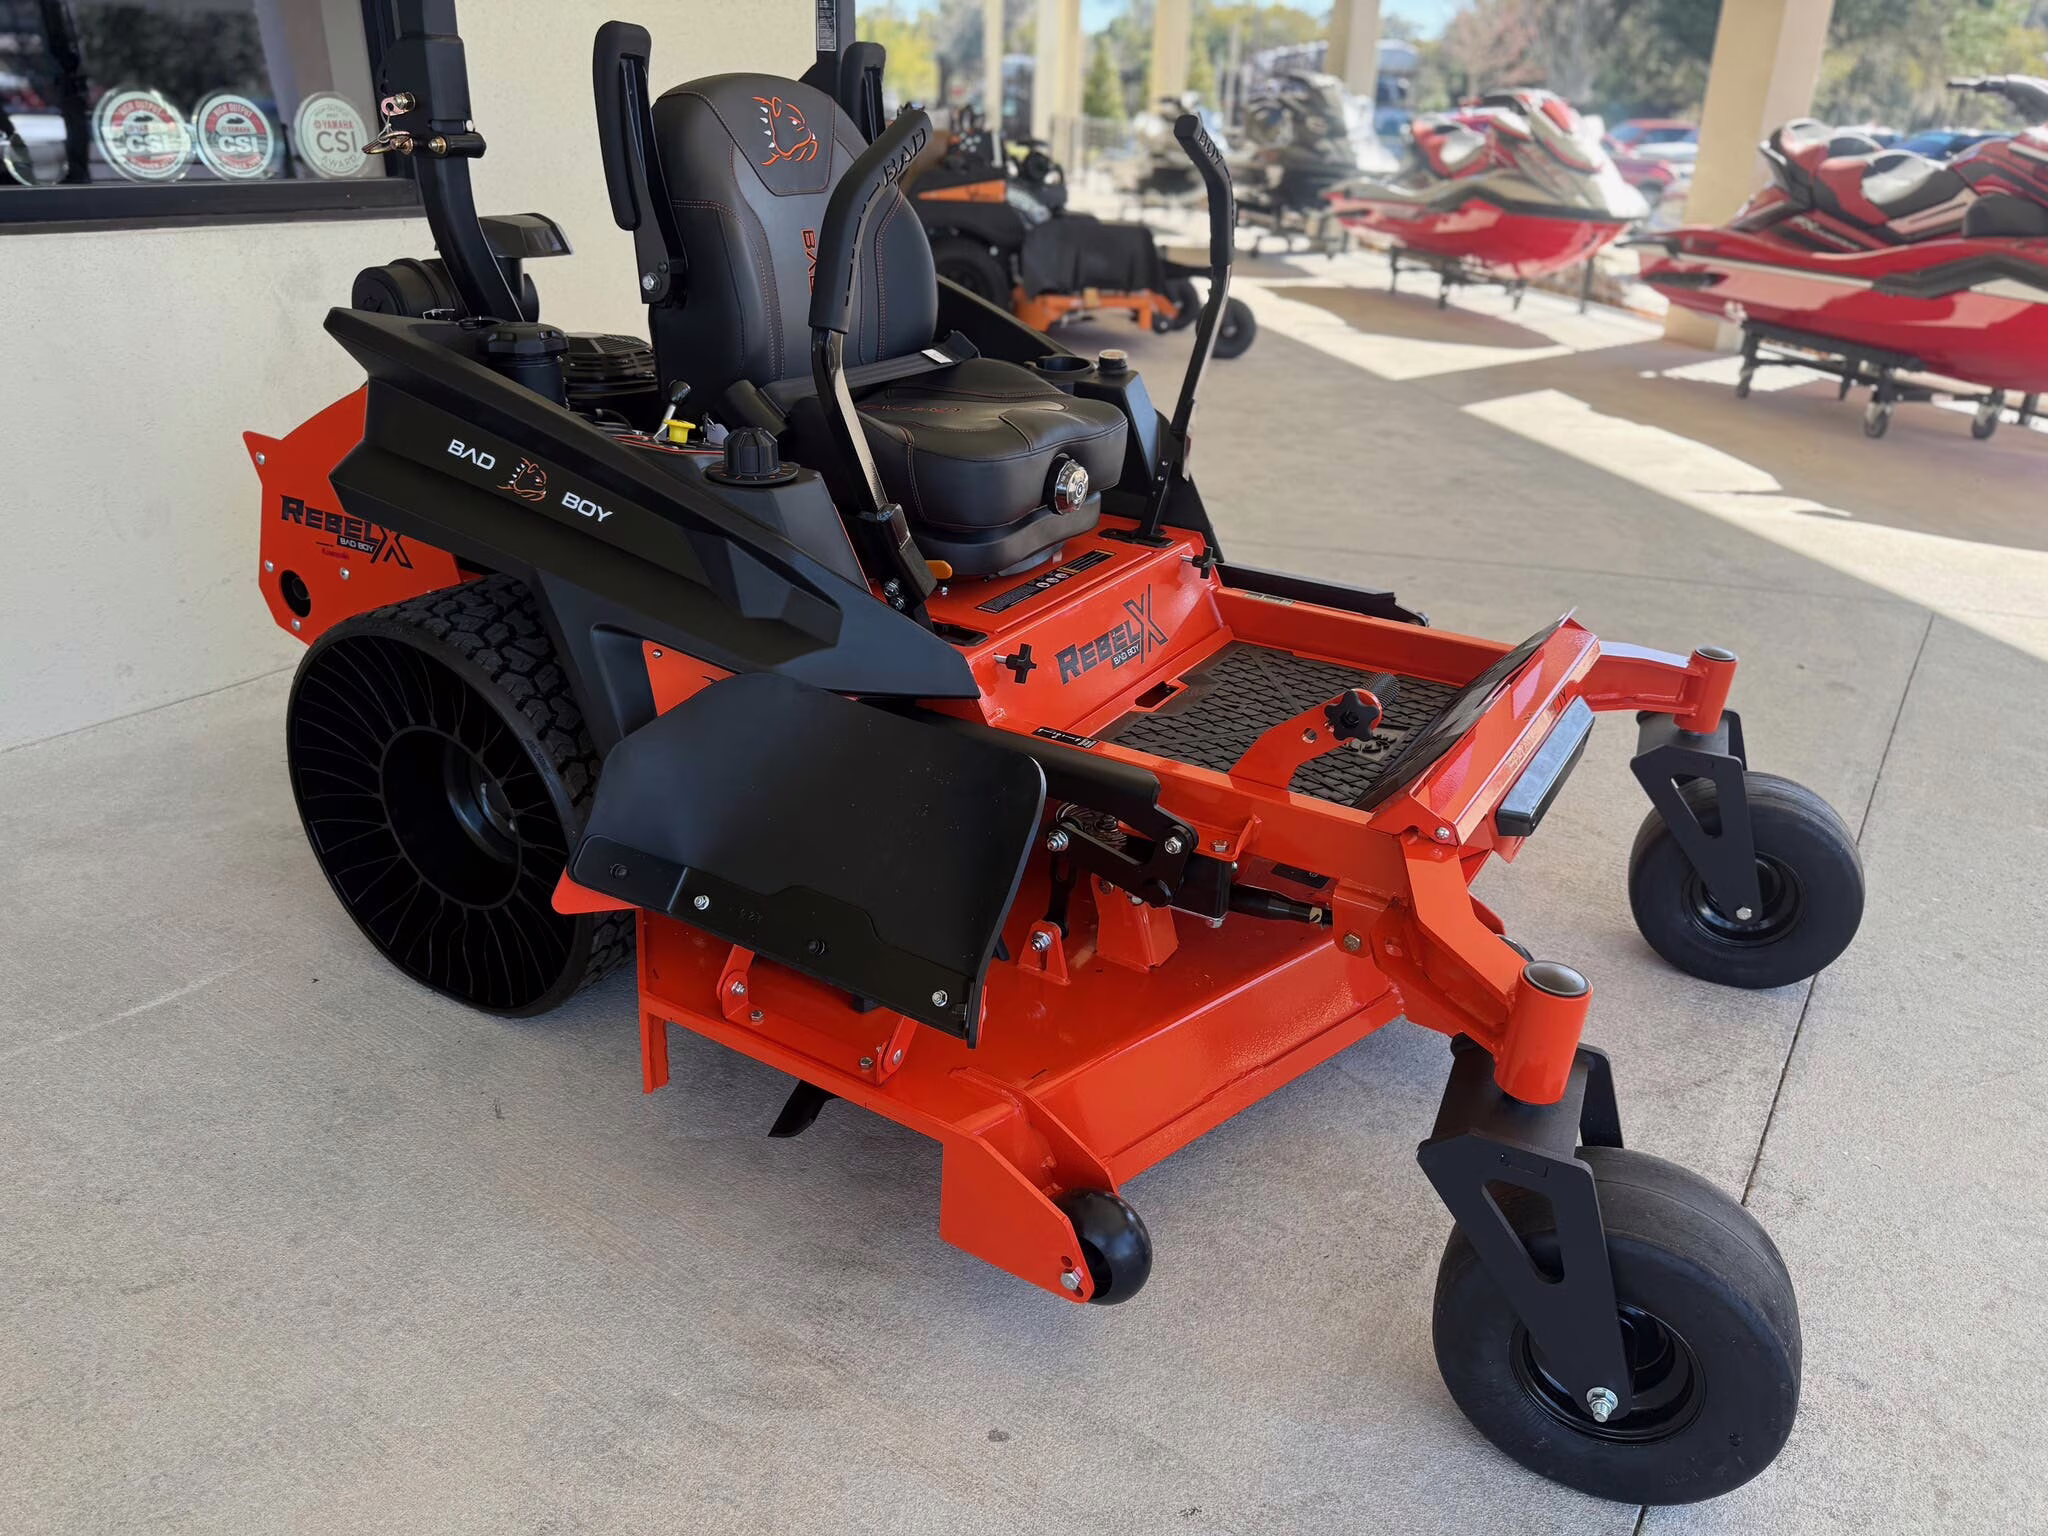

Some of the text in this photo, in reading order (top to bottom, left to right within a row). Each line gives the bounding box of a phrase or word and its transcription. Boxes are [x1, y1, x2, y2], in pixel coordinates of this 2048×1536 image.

[323, 120, 354, 129] YAMAHA
[218, 135, 259, 153] CSI
[316, 130, 358, 153] CSI
[883, 127, 926, 188] BAD
[447, 438, 496, 471] BAD
[561, 491, 613, 522] BOY
[340, 537, 357, 548] BAD
[357, 541, 375, 553] BOY
[1113, 643, 1141, 665] BAD BOY
